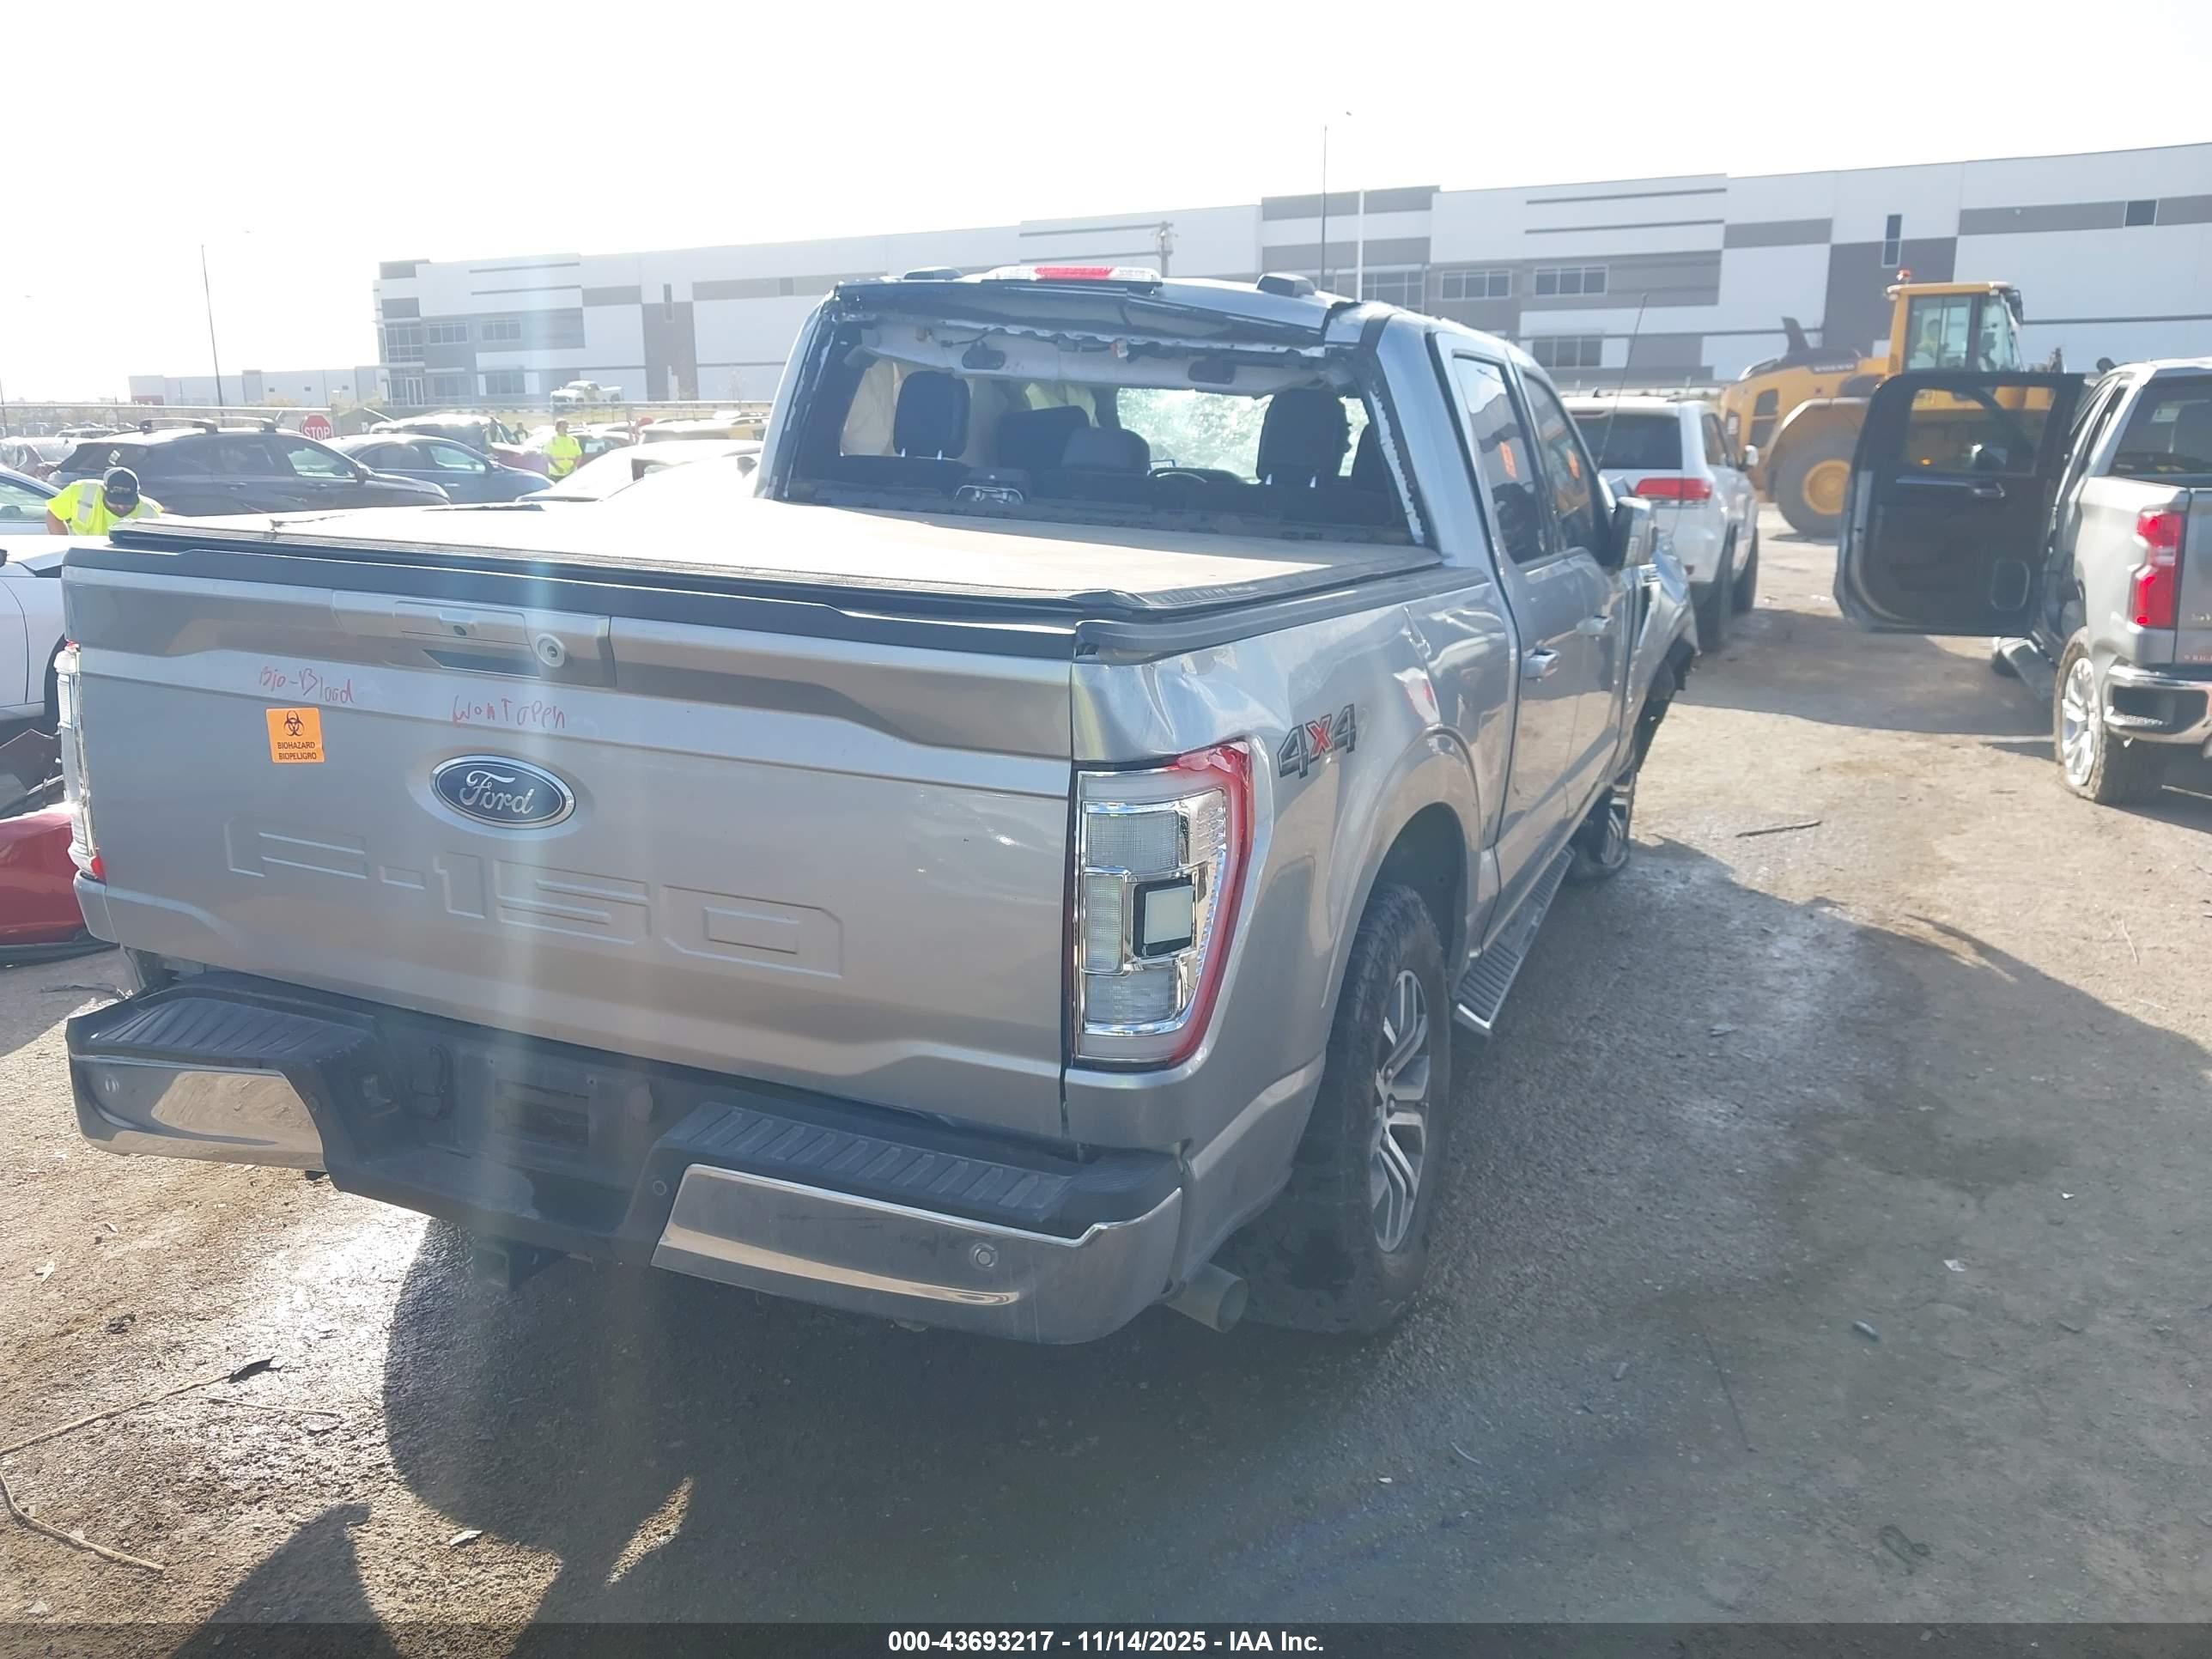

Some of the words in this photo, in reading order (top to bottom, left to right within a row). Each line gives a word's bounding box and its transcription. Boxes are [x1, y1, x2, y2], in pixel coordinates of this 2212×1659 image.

[303, 426, 331, 441] STOP
[276, 741, 315, 750] BIOHAZARD
[459, 770, 535, 815] Ford
[226, 815, 843, 979] F-150
